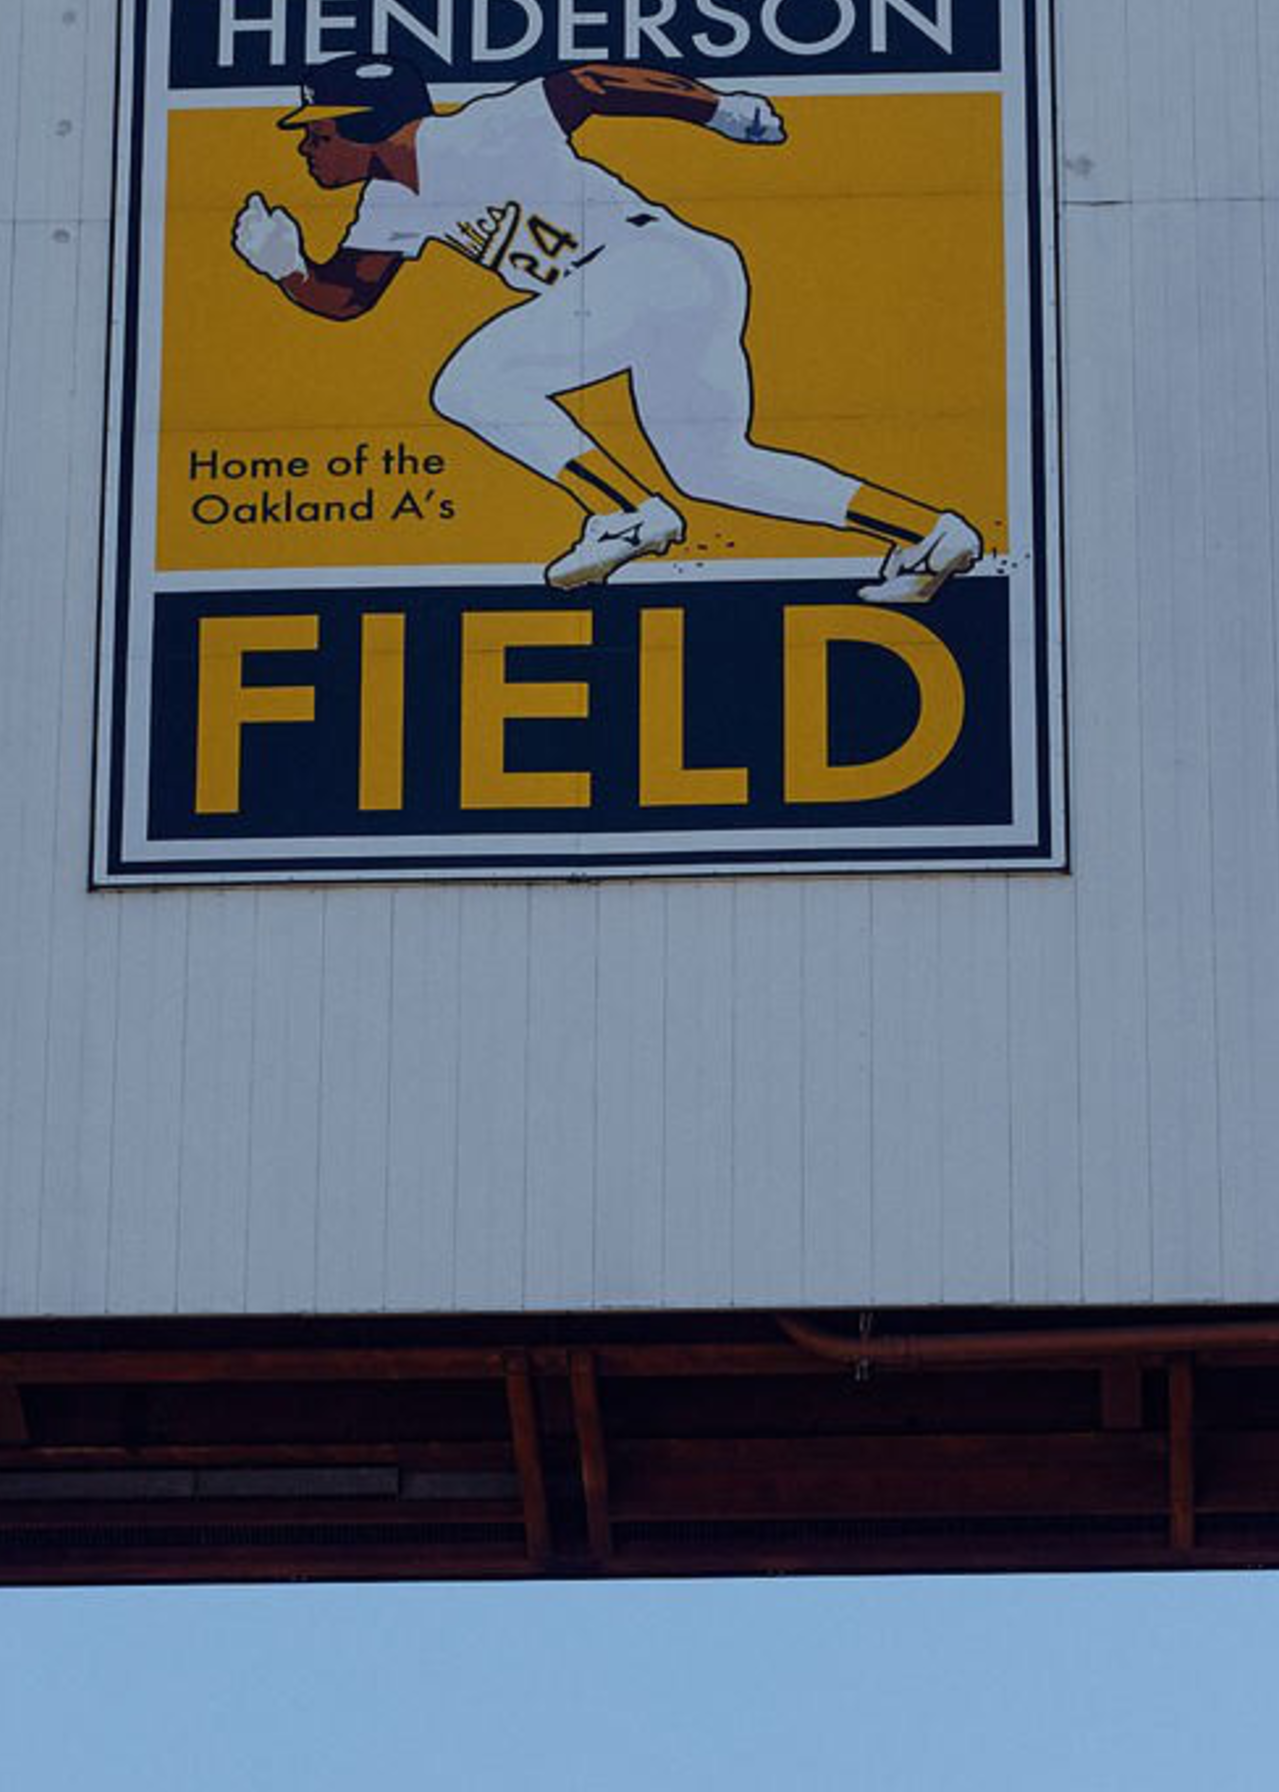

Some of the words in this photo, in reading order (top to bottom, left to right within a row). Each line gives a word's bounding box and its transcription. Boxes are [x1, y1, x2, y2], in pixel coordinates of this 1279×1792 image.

[509, 215, 578, 285] 24
[189, 449, 310, 481] Home
[326, 442, 370, 477] of
[381, 442, 445, 475] the
[191, 487, 374, 525] Oakland
[390, 488, 455, 521] A's
[195, 604, 966, 814] FIELD
